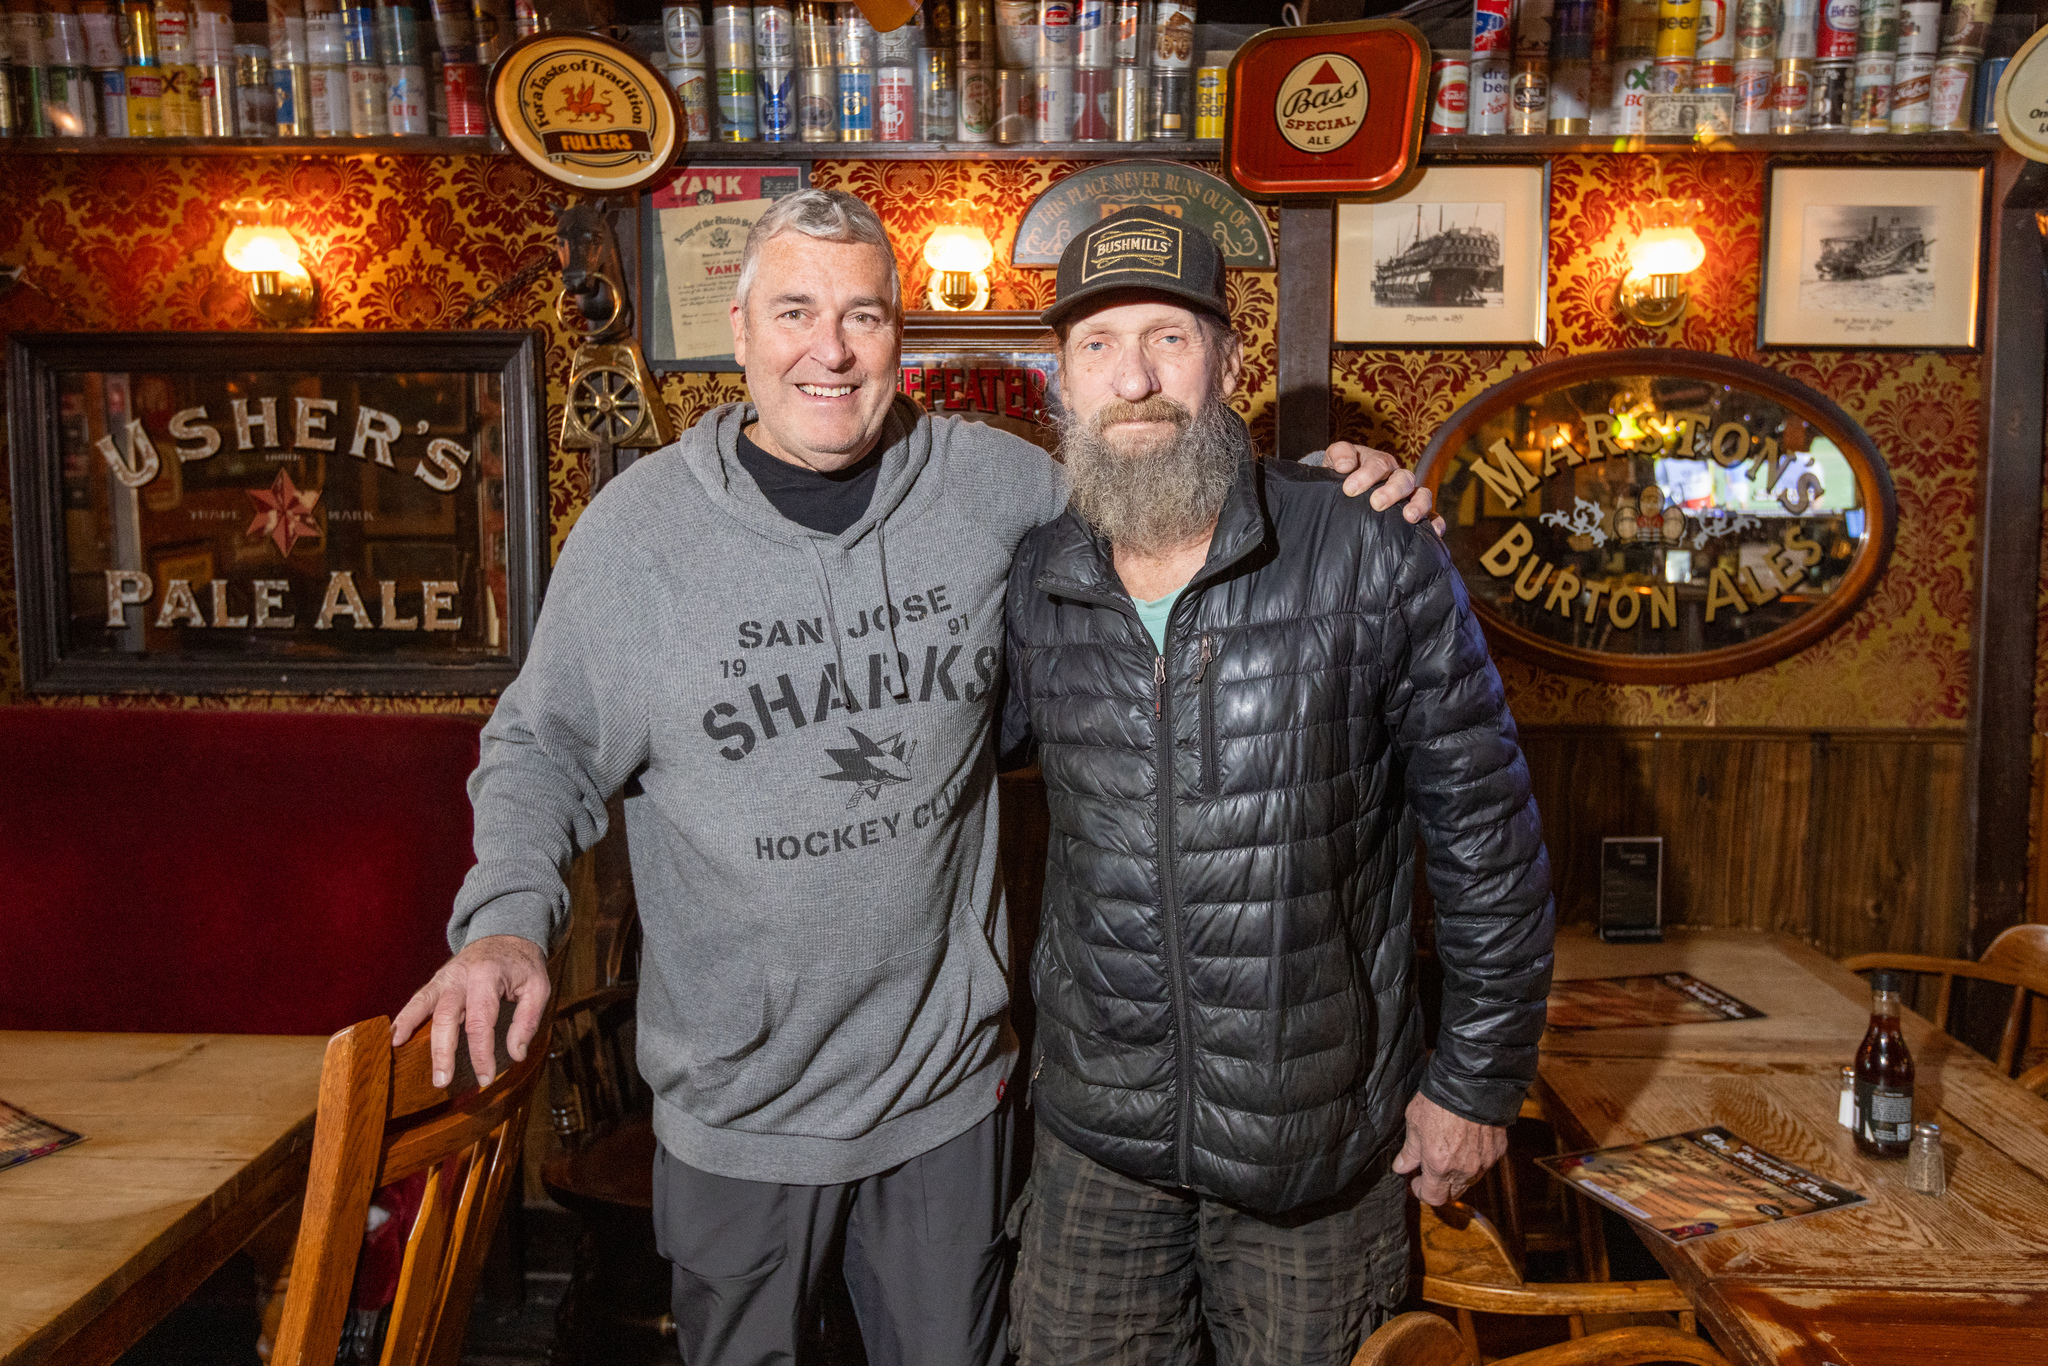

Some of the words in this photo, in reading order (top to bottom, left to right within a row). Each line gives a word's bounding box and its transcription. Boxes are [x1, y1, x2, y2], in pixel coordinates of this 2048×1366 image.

[530, 64, 569, 90] Taste
[570, 58, 588, 72] of
[533, 91, 543, 101] a
[590, 59, 643, 125] Tradition
[1283, 80, 1359, 118] Bass
[533, 101, 550, 128] For
[1285, 116, 1357, 132] SPECIAL
[560, 133, 634, 151] FULLERS
[1307, 136, 1331, 145] ALE
[672, 176, 743, 196] YANK
[1036, 196, 1068, 225] THIS
[1067, 175, 1111, 205] PLACE
[1112, 171, 1161, 190] NEVER
[1165, 173, 1202, 199] RUNS
[1203, 188, 1231, 216] OUT
[1233, 209, 1251, 230] OF
[1096, 237, 1170, 257] BUSHMILLS
[705, 263, 742, 276] YANK
[896, 367, 1050, 425] EFEATER
[96, 397, 472, 491] USHER'S
[1469, 411, 1825, 514] MARSTON'S
[1480, 521, 1678, 630] BURTON
[1705, 525, 1822, 623] ALES
[104, 569, 295, 630] PALE
[314, 570, 464, 631] ALE
[738, 617, 825, 650] SAN
[846, 585, 953, 640] JOSE
[720, 658, 747, 679] 19
[702, 645, 998, 762] SHARKS
[755, 812, 901, 861] HOCKEY
[913, 778, 967, 828] CLU
